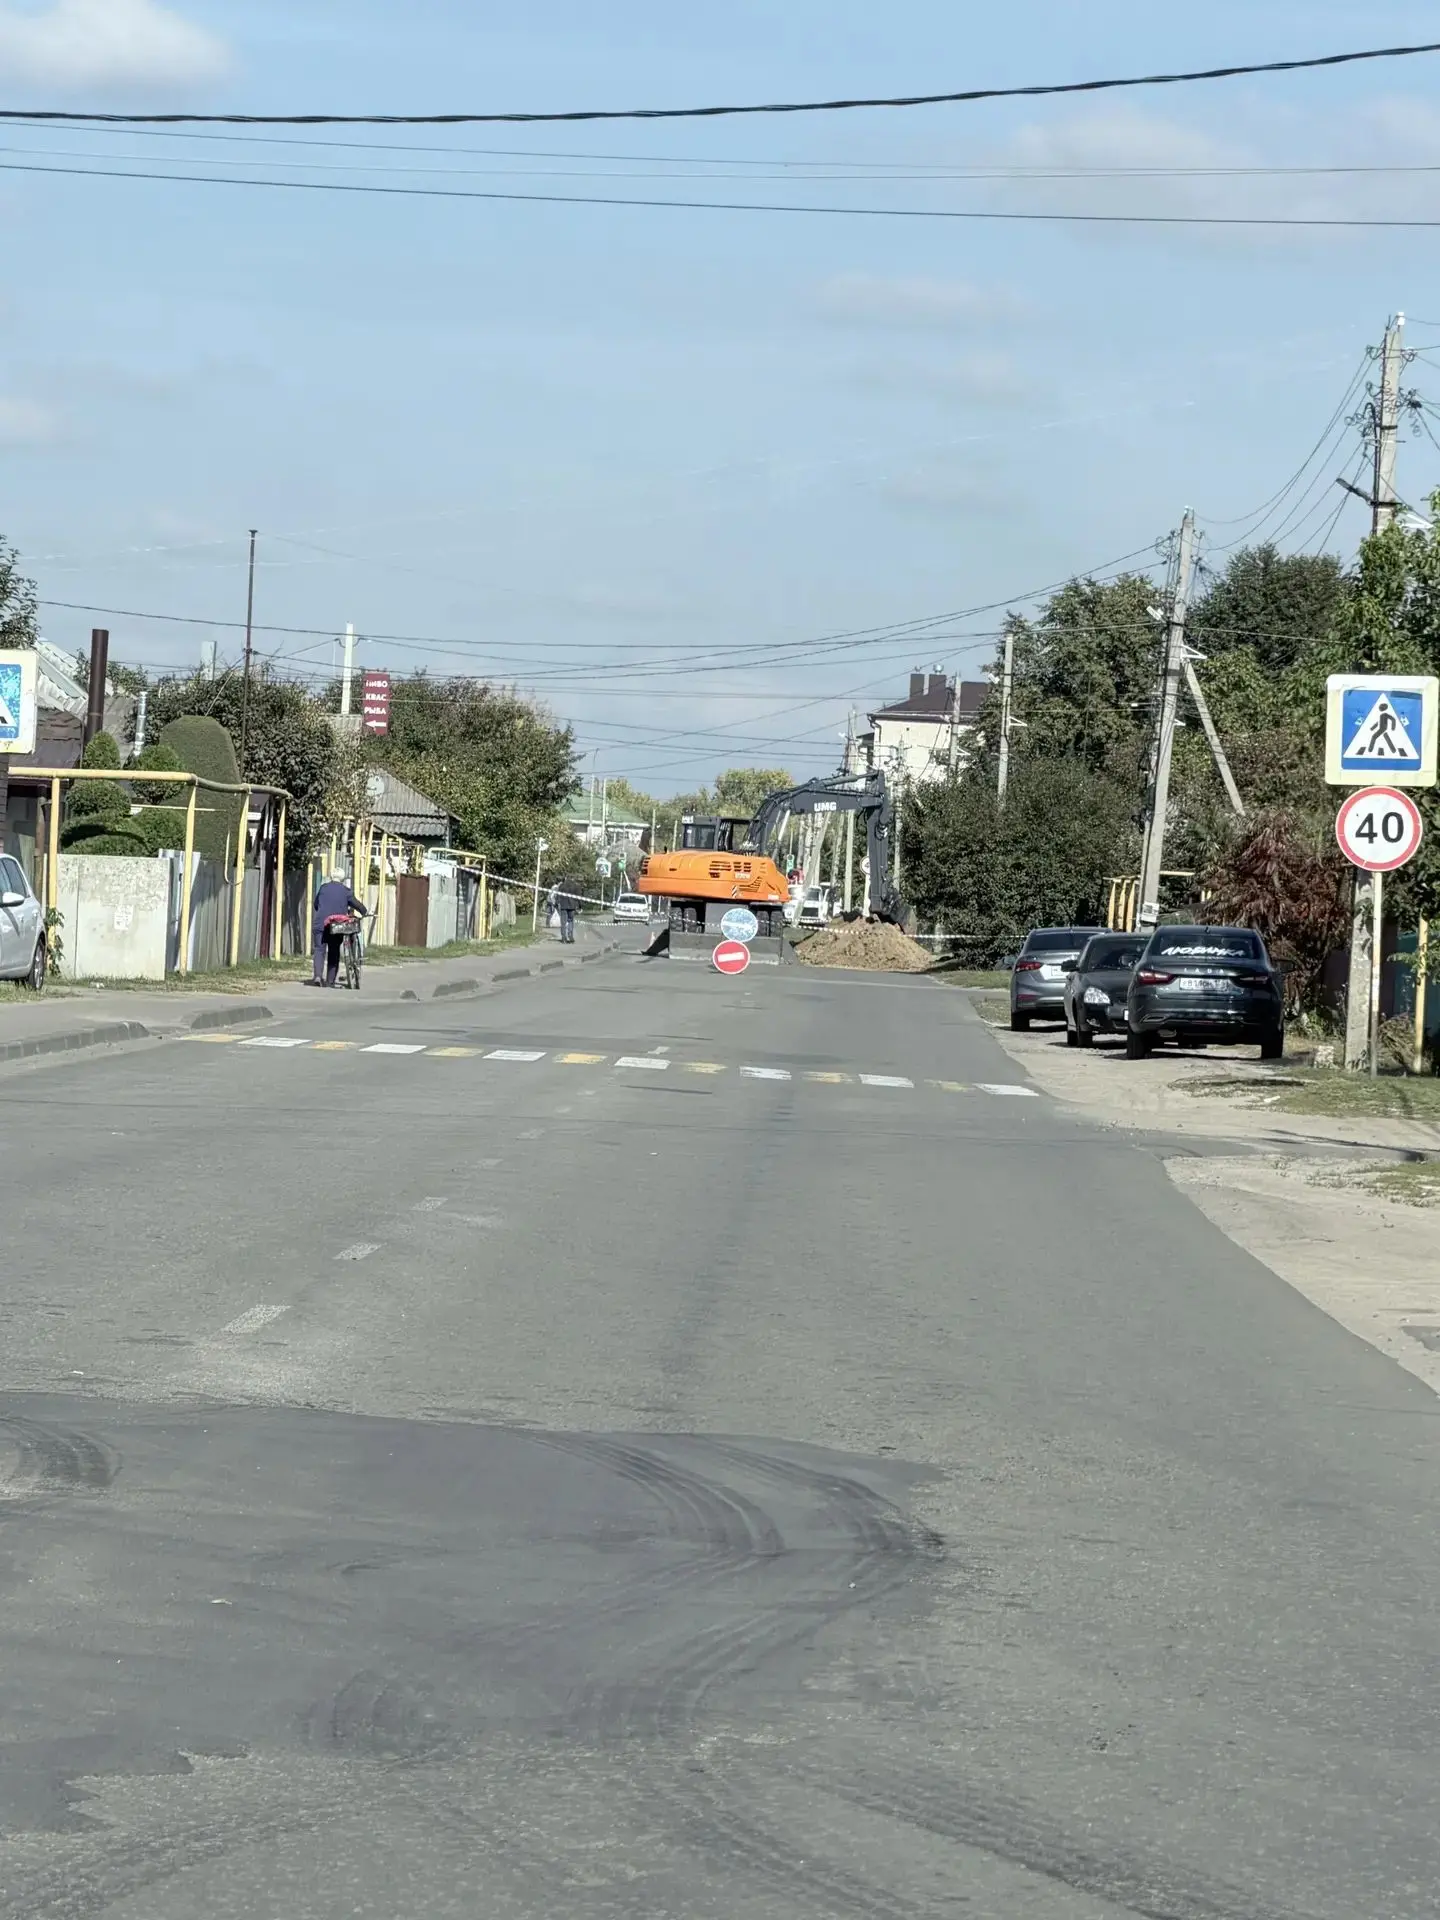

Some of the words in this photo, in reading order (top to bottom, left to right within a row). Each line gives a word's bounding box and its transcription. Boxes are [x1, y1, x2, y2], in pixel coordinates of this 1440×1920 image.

[365, 693, 387, 701] КВАС
[364, 707, 387, 715] РЫБА
[814, 802, 837, 812] UMG
[1355, 812, 1404, 844] 40
